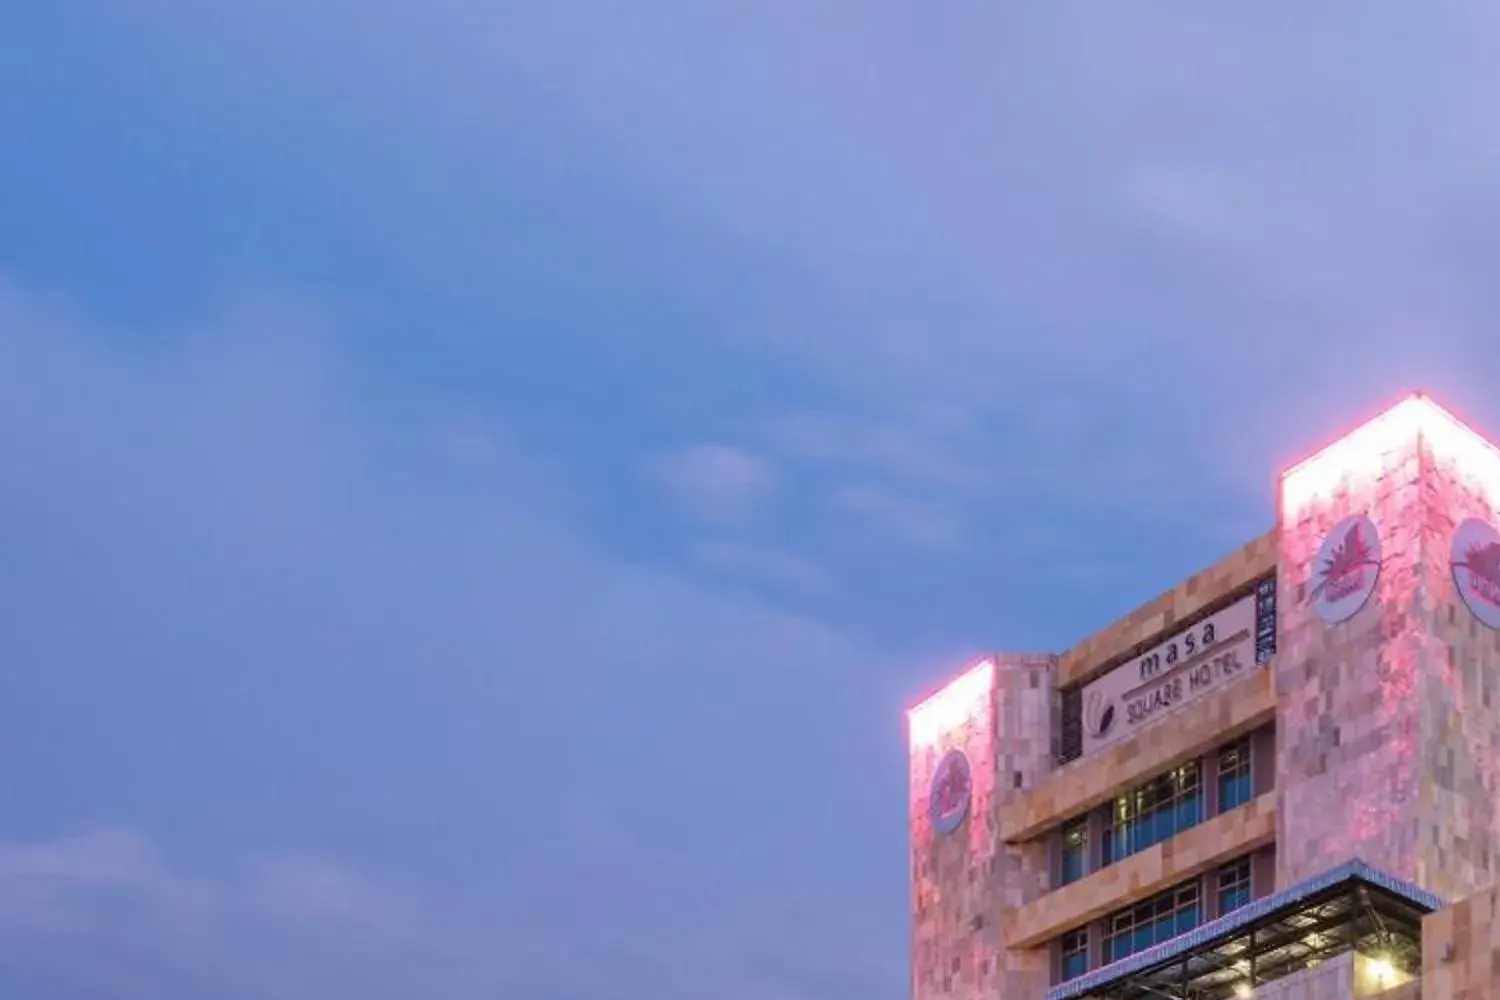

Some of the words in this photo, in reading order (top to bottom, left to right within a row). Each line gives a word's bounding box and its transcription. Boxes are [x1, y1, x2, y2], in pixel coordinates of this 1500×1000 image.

[1139, 623, 1215, 680] masa
[1127, 679, 1183, 725] SQUARE
[1190, 652, 1243, 690] HOTEL
